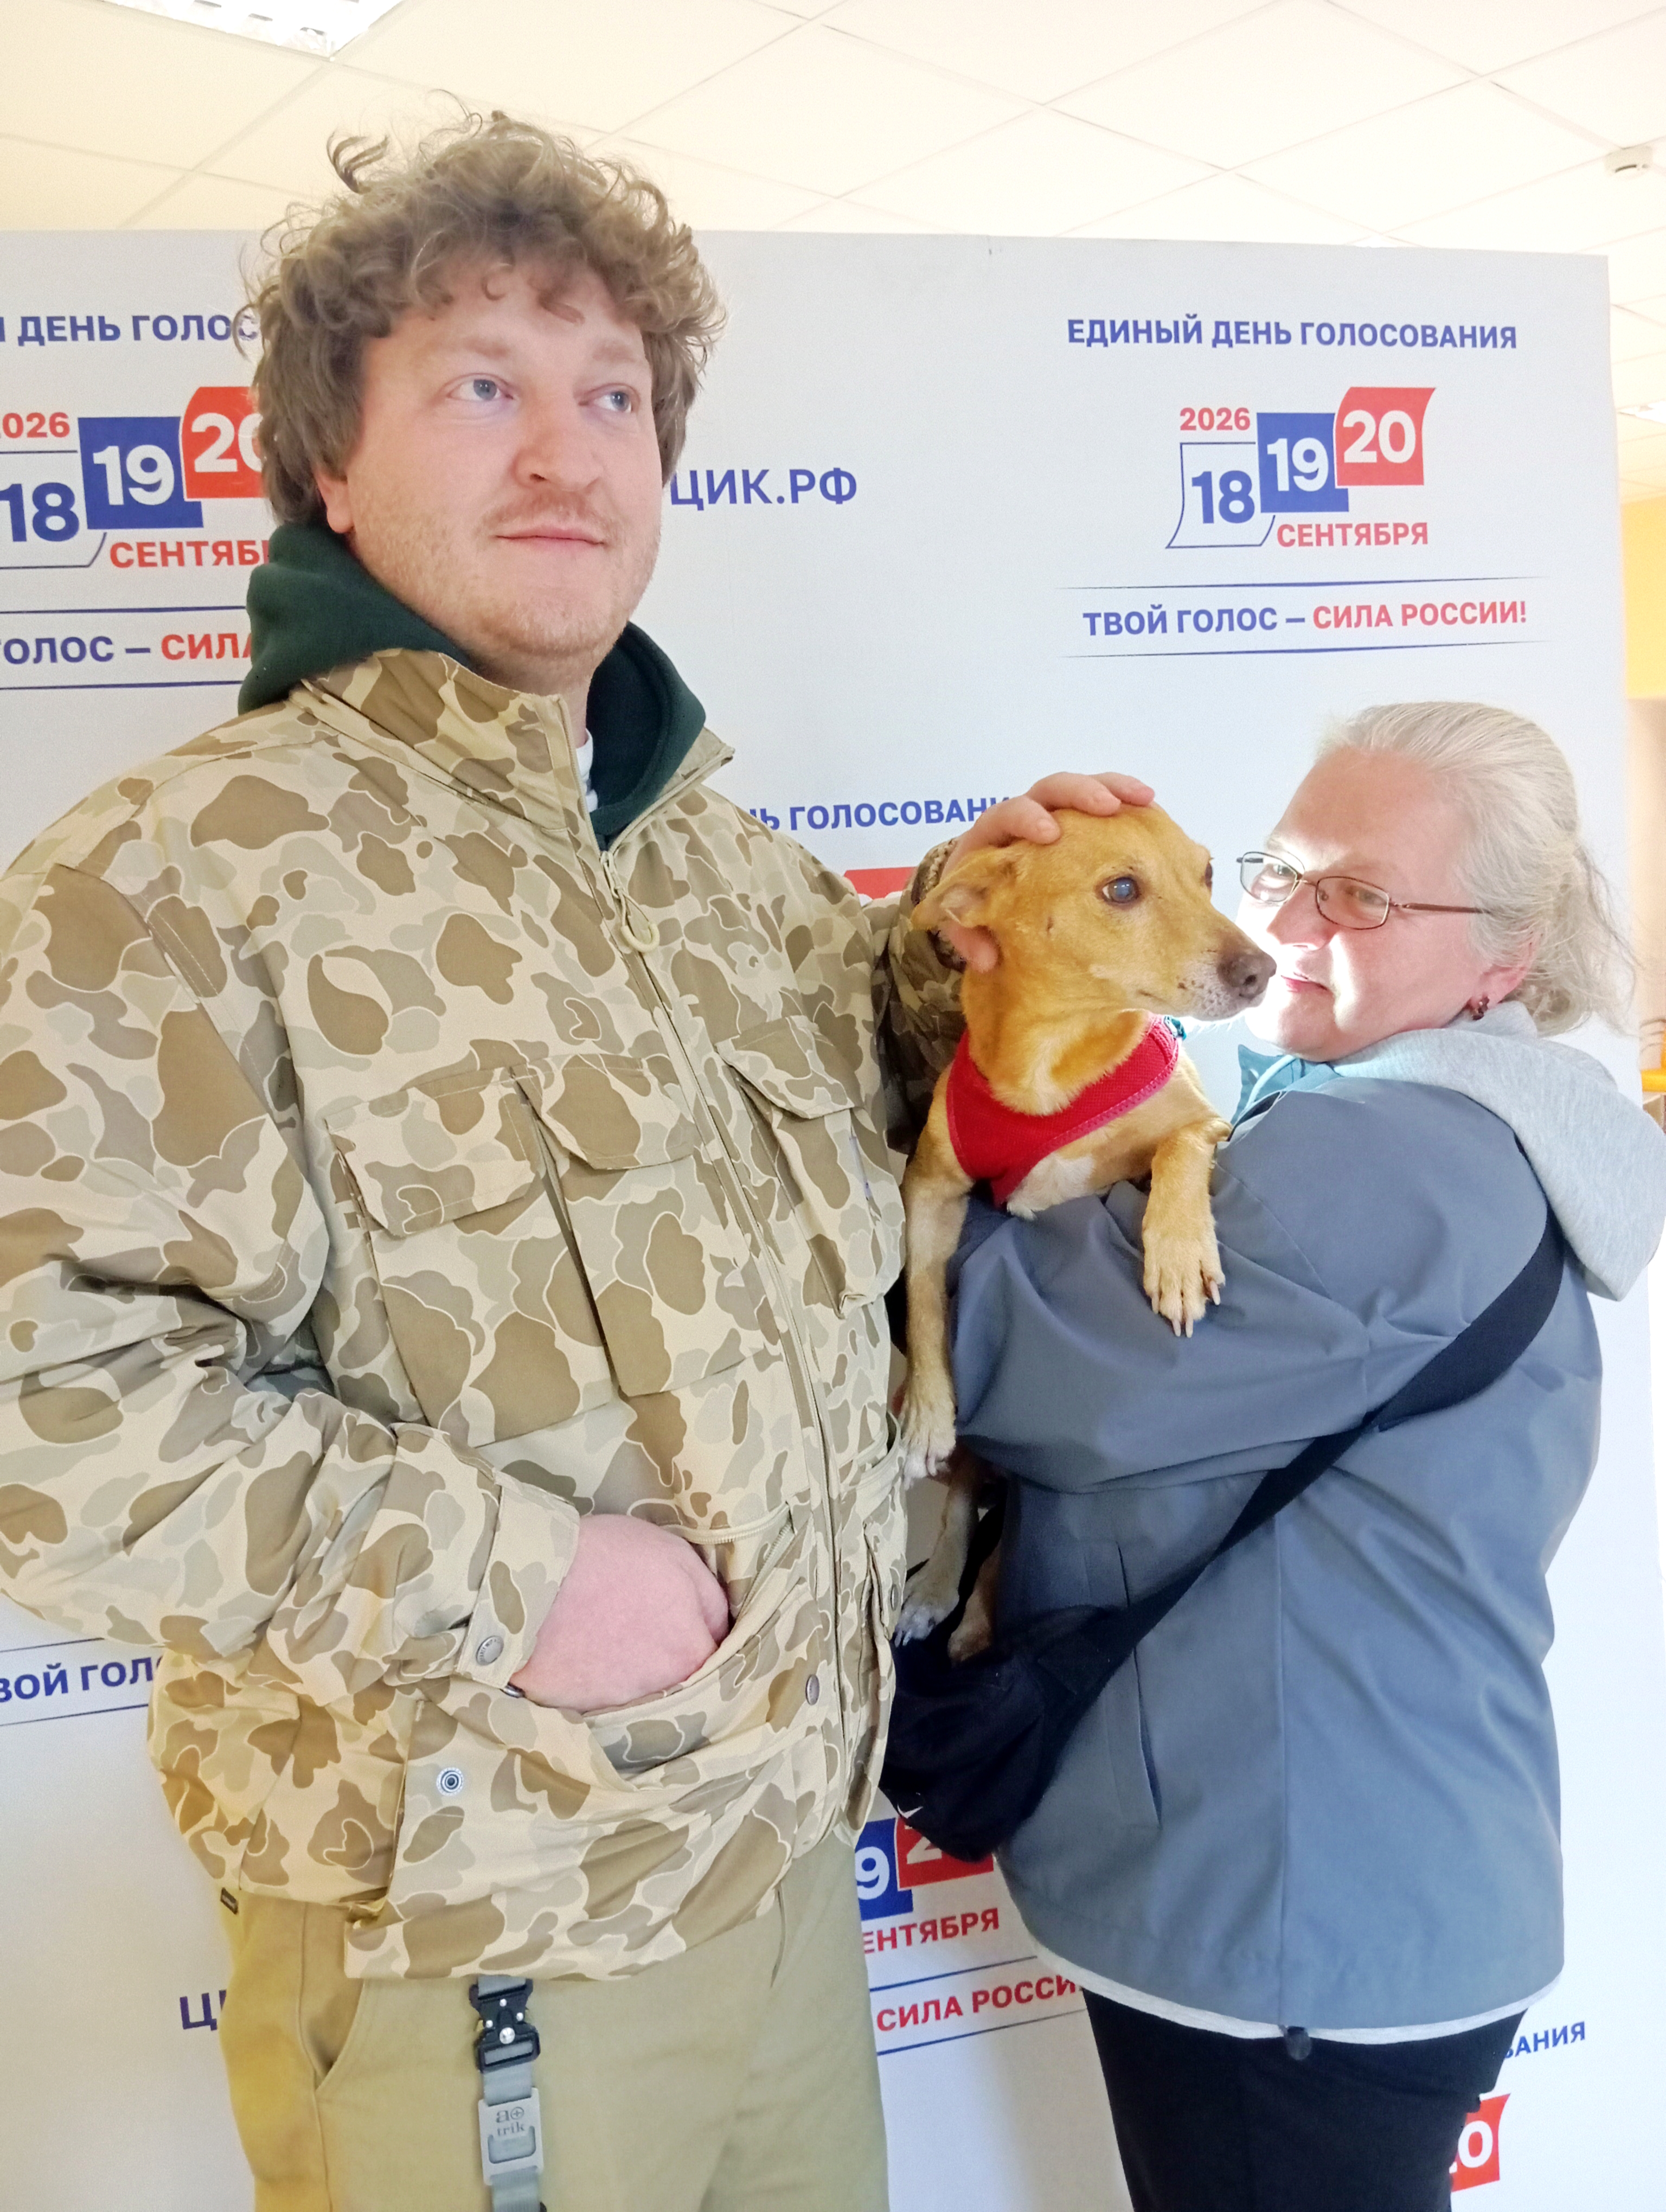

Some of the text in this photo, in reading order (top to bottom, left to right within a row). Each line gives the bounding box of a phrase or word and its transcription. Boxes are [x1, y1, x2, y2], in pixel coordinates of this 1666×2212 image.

[18, 316, 121, 346] ДЕНЬ
[1068, 313, 1516, 348] ЕДИНЫЙ ДЕНЬ ГОЛОСОВАНИЯ
[0, 412, 70, 438] 026
[1180, 407, 1251, 431] 2026
[1191, 409, 1416, 524] 18 19 20
[0, 482, 79, 542] 18
[93, 444, 175, 505] 19
[670, 467, 857, 511] ЦИК.РФ
[1277, 522, 1428, 547] СЕНТЯБРЯ
[1082, 604, 1167, 636] ТВОЙ
[1177, 607, 1277, 633] ГОЛОС
[1313, 605, 1393, 629] СИЛА
[1401, 601, 1526, 626] РОССИИ!
[0, 636, 114, 664] ОЛОС
[790, 797, 1009, 831] ГОЛОСОВАН
[81, 1656, 163, 1691] ГОЛ
[877, 1996, 964, 2031] СИЛА
[1504, 2021, 1585, 2059] АНИЯ
[1449, 2120, 1494, 2174] 0
